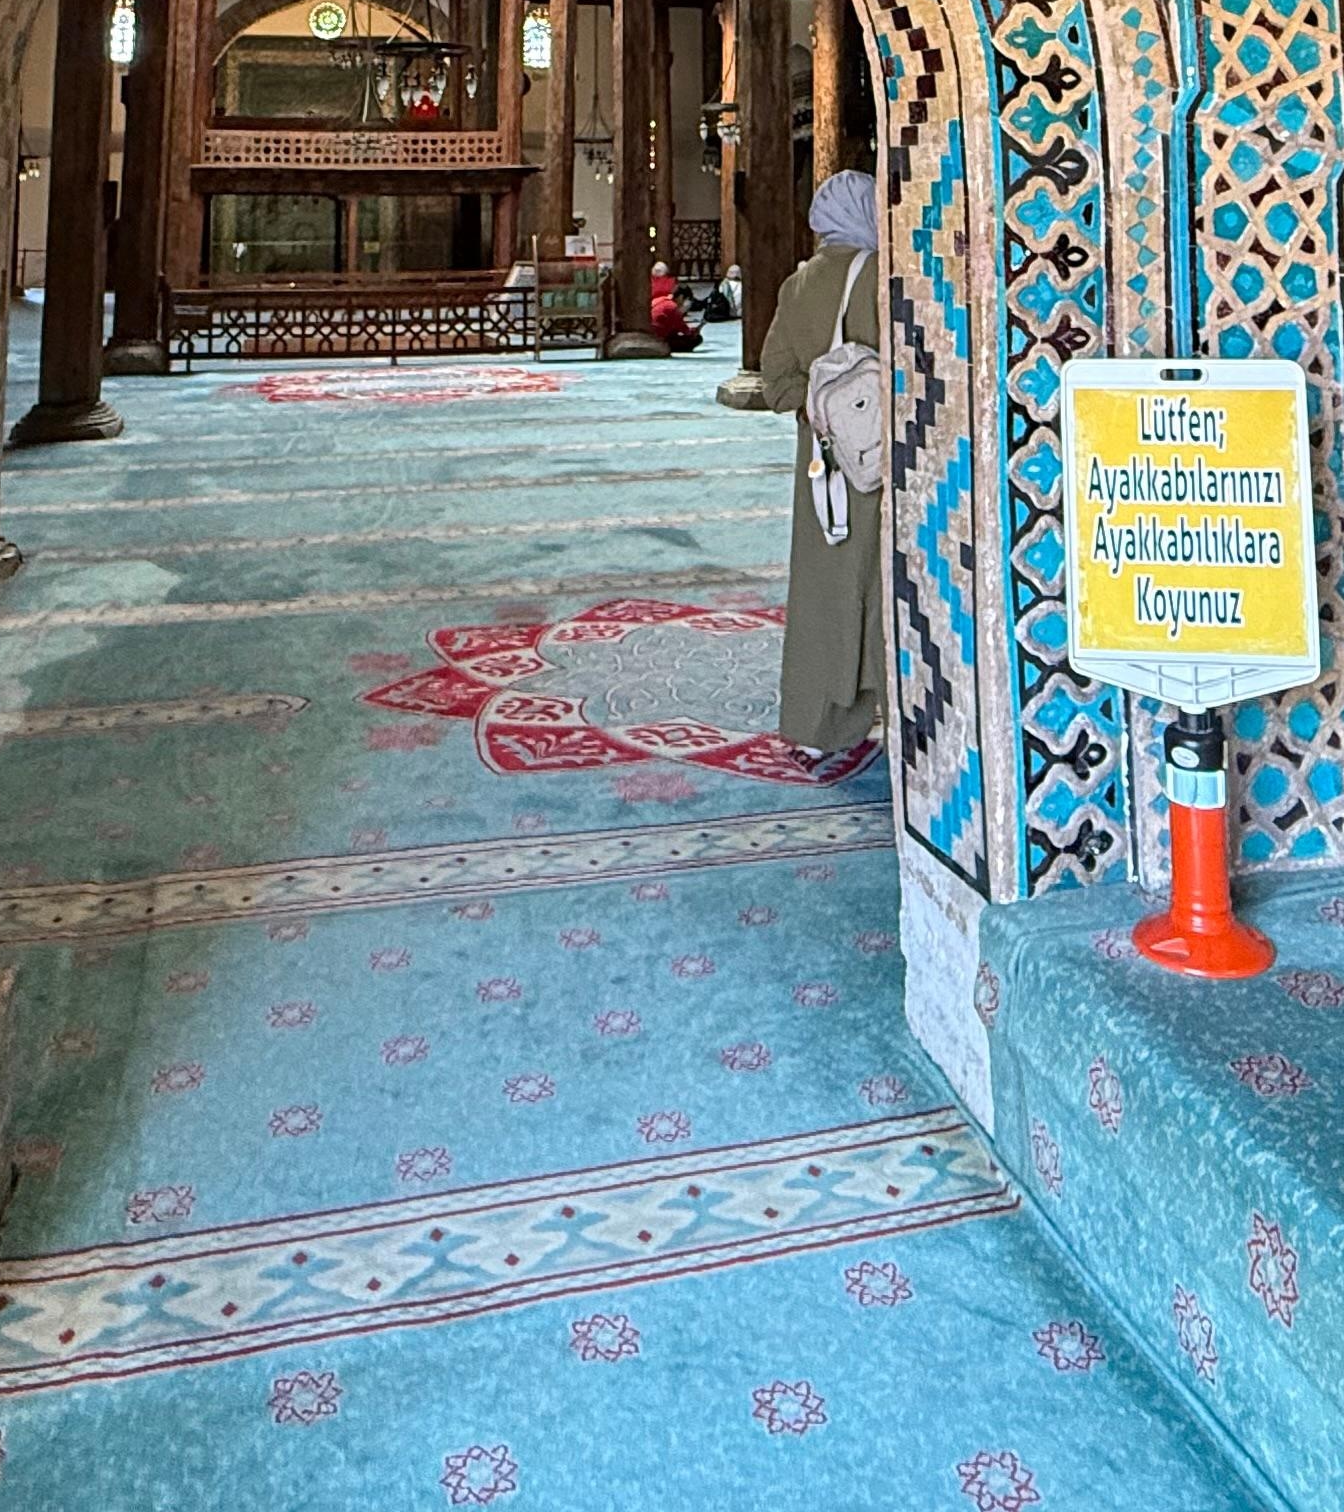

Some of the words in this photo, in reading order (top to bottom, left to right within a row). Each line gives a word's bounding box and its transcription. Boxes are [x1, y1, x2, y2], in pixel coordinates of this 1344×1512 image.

[1139, 397, 1223, 449] Lütfen;
[1088, 457, 1282, 514] Ayakkabılarınızı
[1093, 516, 1281, 574] Ayakkabılıklara
[1137, 576, 1242, 636] Koyunuz
